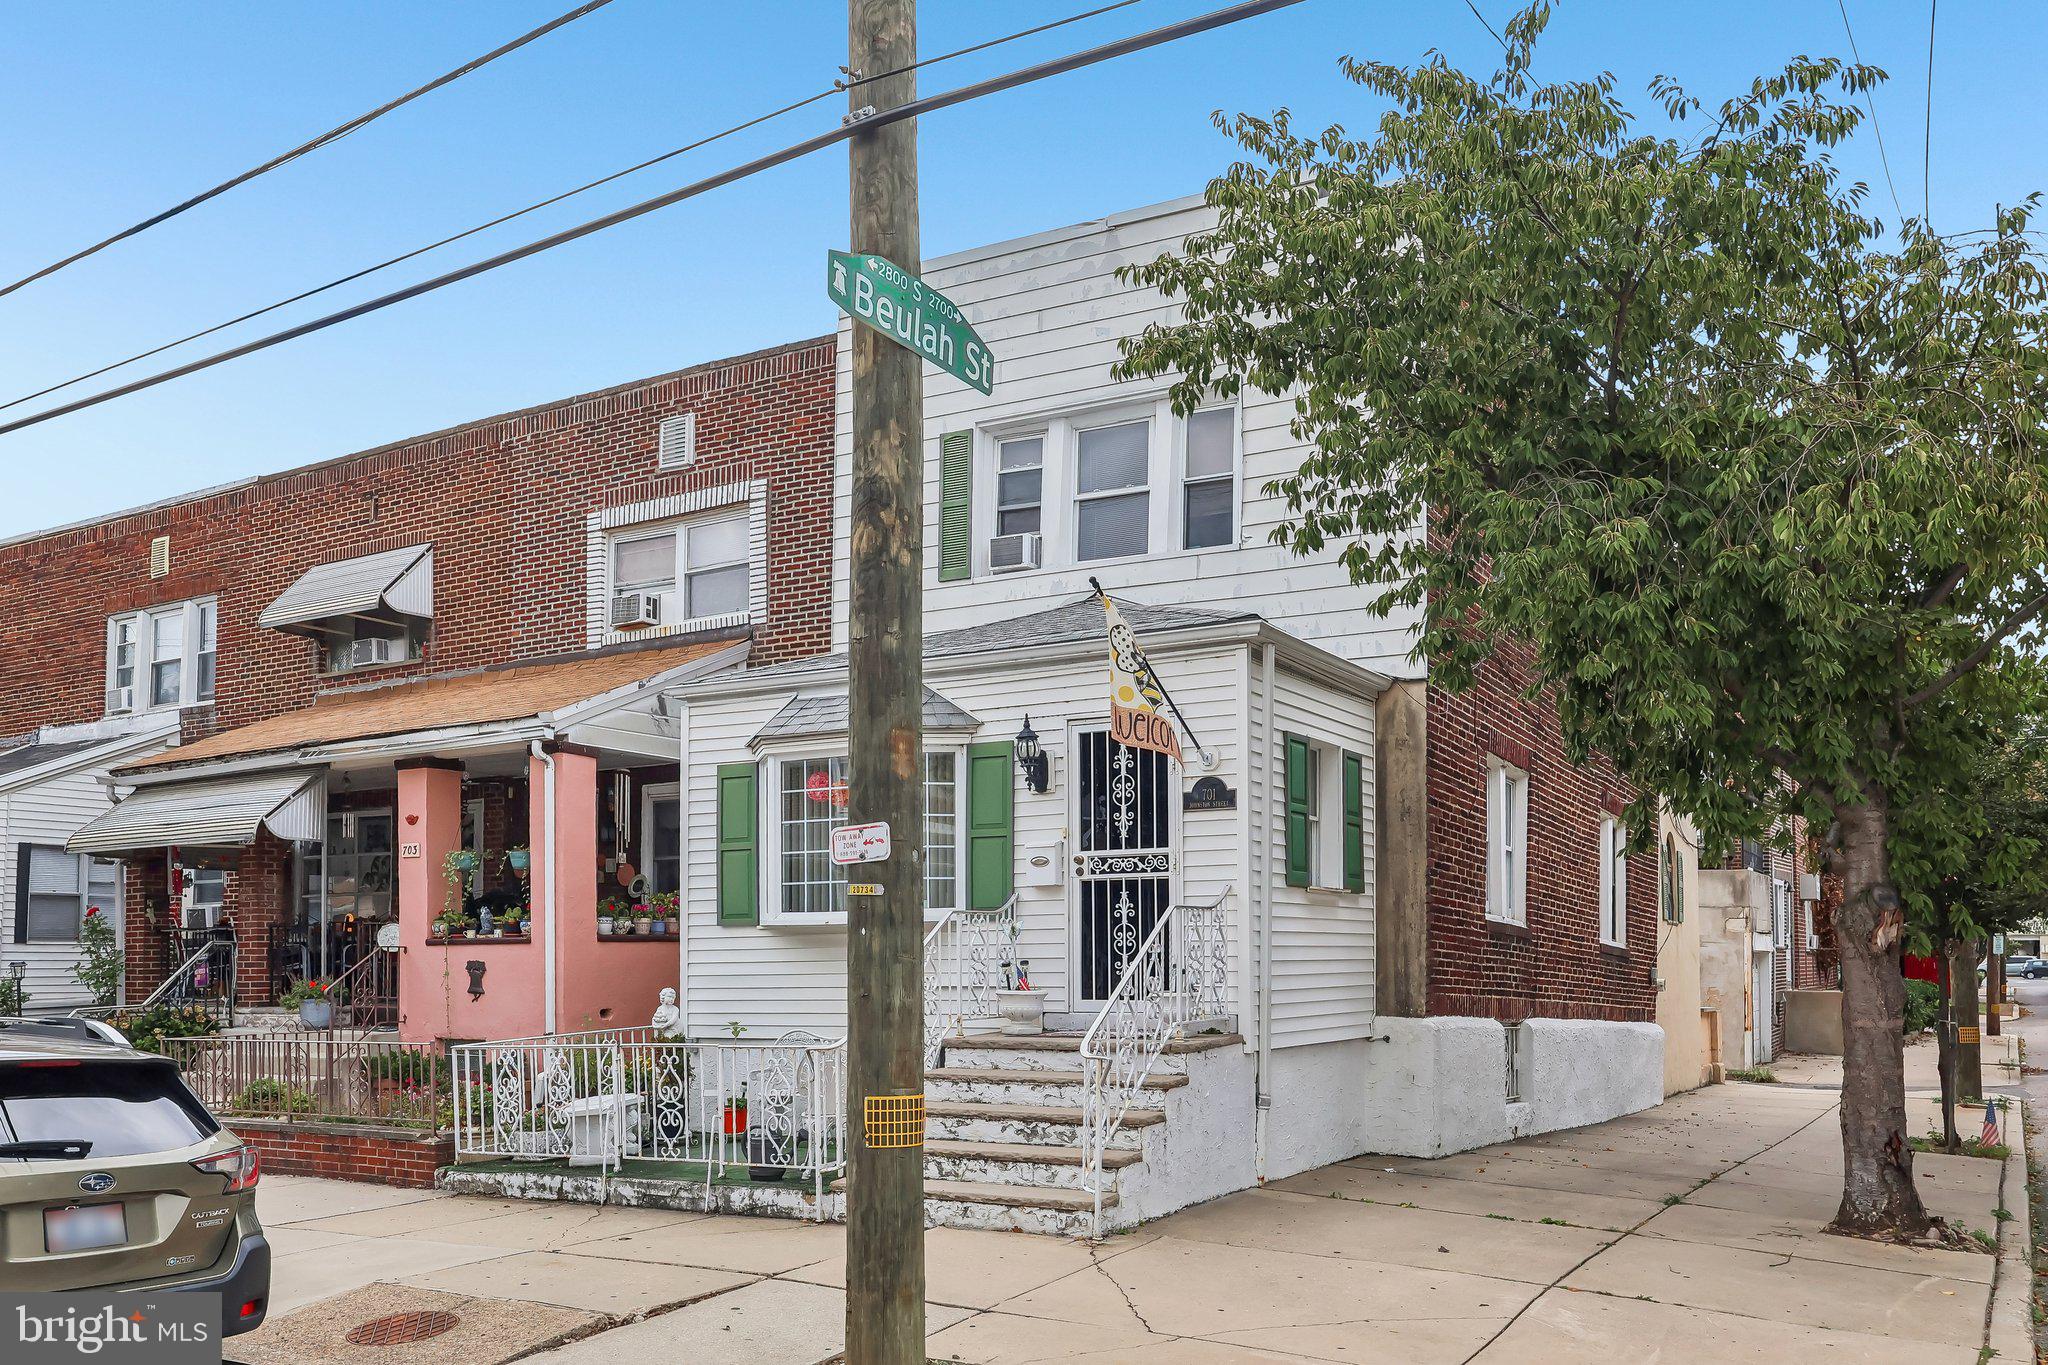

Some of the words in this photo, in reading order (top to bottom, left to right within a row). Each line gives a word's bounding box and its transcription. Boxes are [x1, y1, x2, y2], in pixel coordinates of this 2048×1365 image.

[878, 262, 908, 290] 2800
[912, 281, 922, 302] S
[929, 294, 954, 319] 2700
[855, 272, 954, 366] Beulah
[965, 341, 991, 389] St
[1202, 788, 1216, 800] 701
[402, 845, 418, 855] 703
[843, 841, 857, 849] ZONE
[853, 886, 873, 894] 20734
